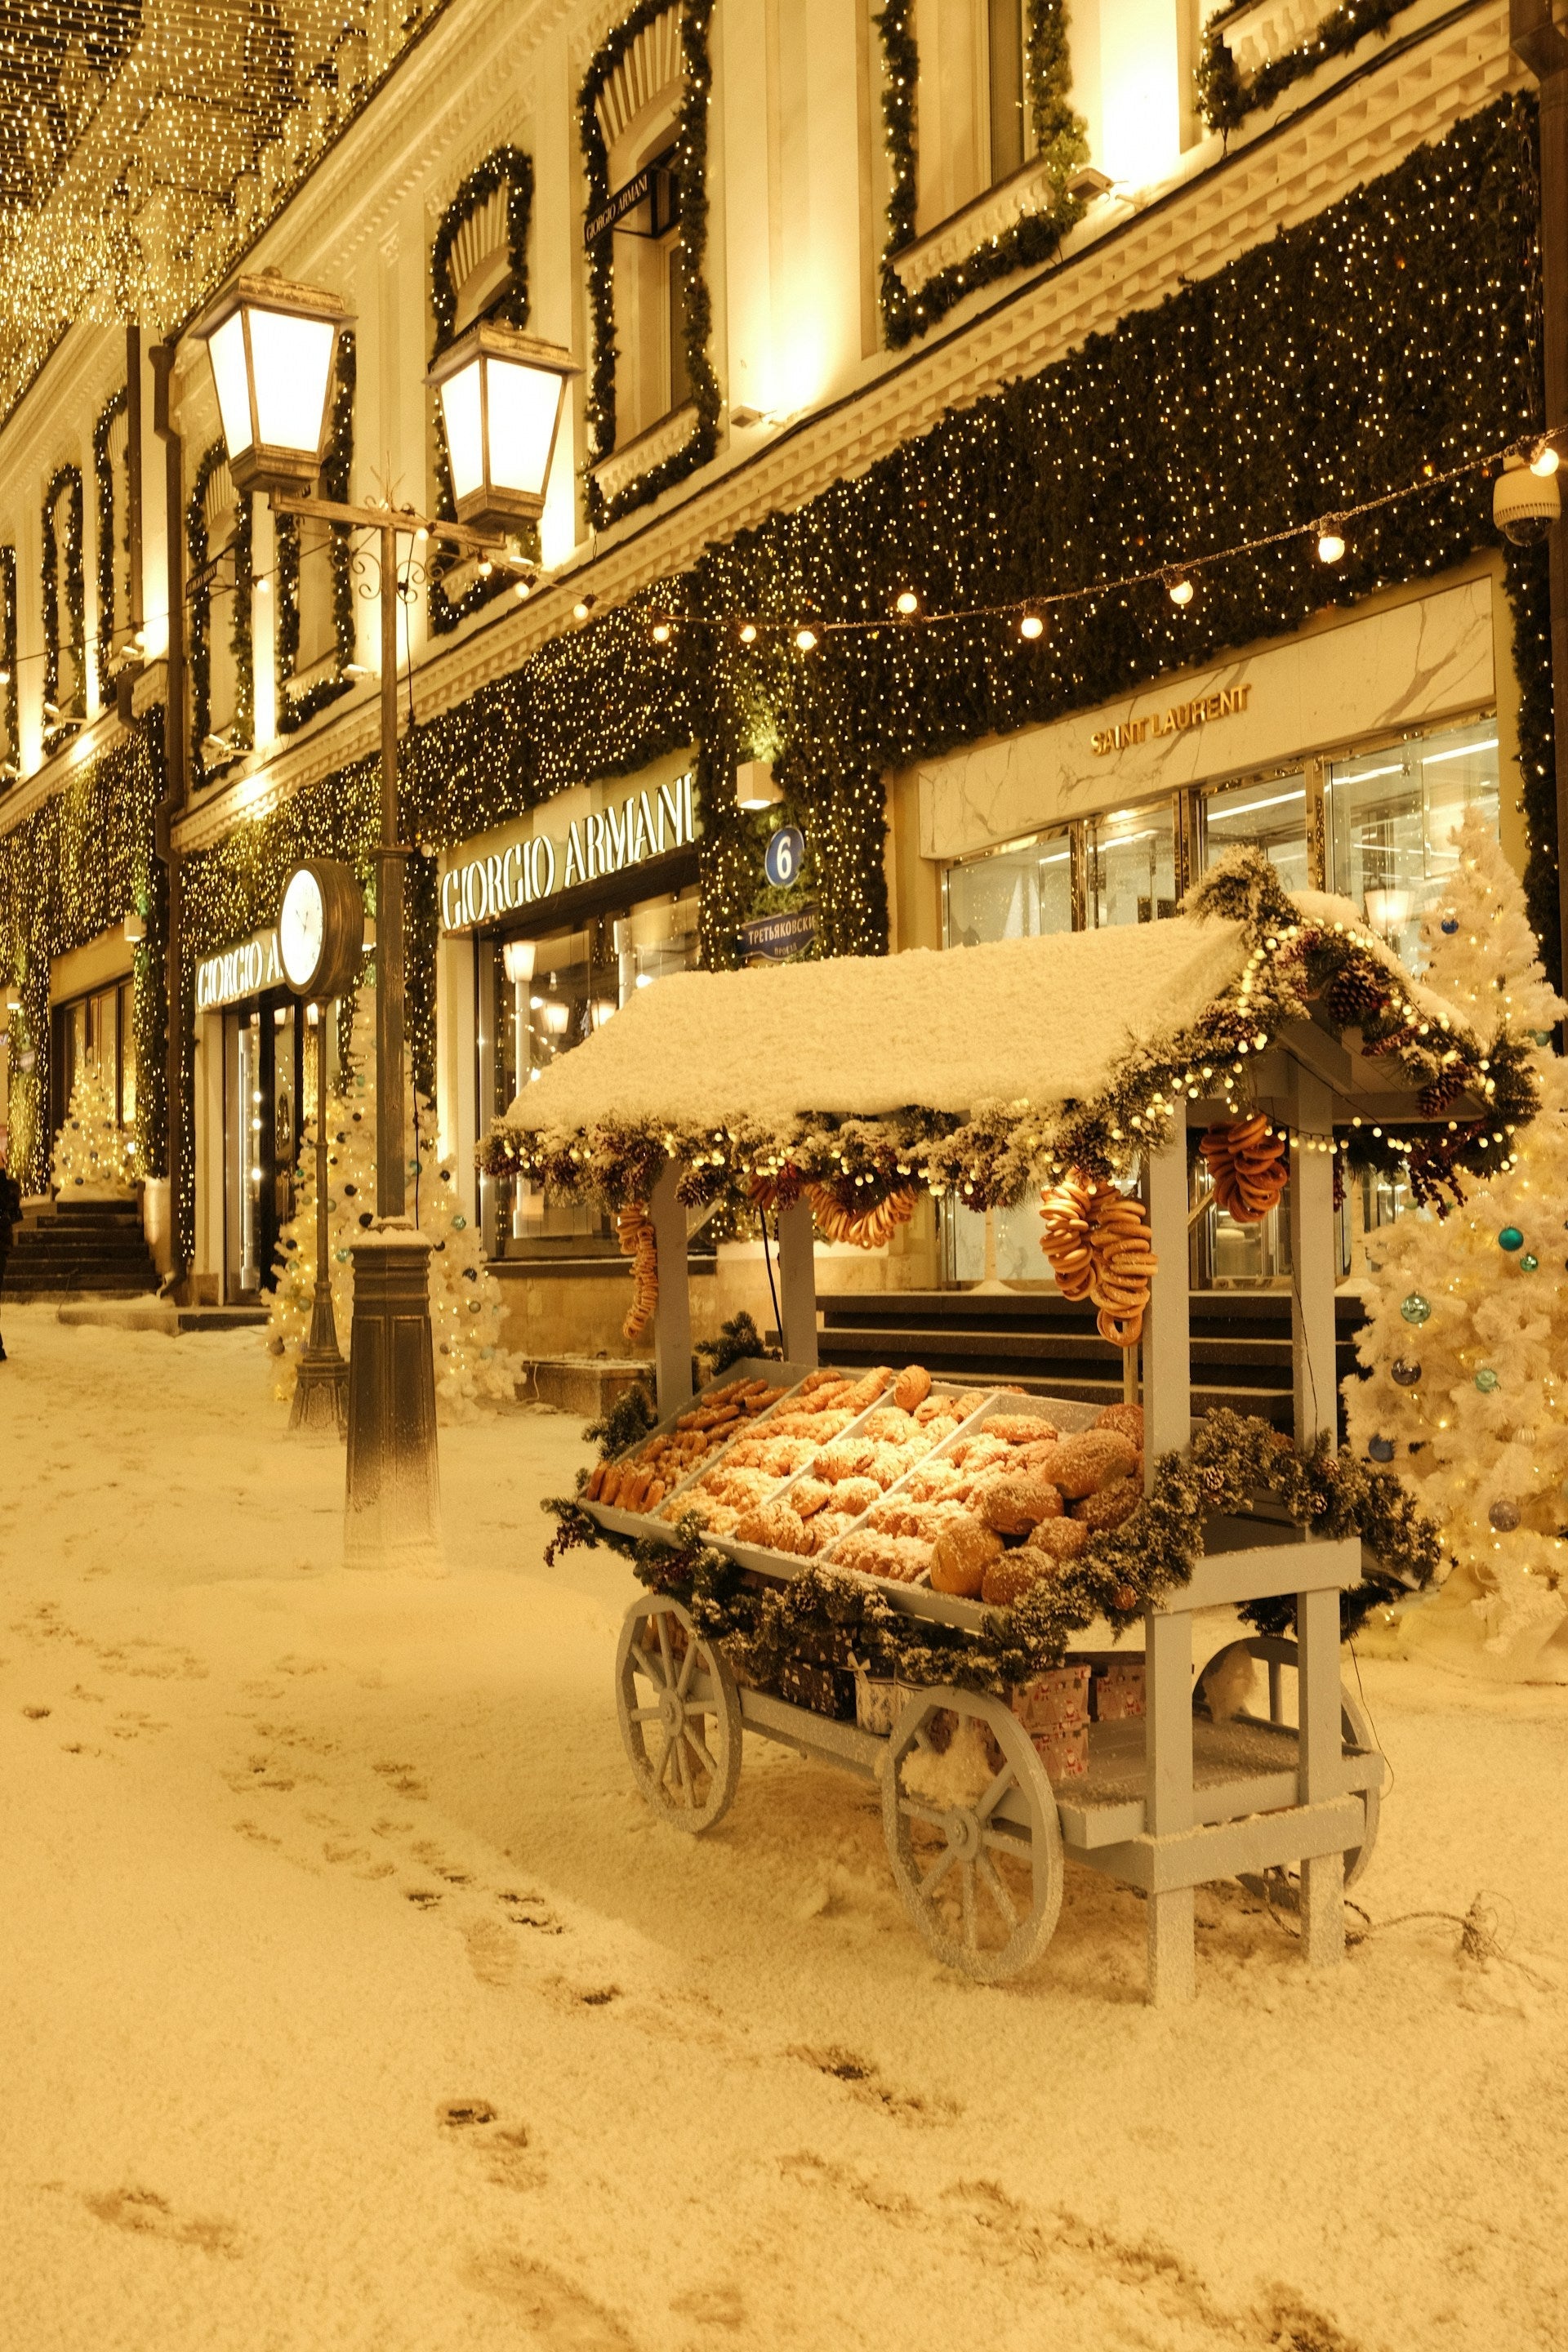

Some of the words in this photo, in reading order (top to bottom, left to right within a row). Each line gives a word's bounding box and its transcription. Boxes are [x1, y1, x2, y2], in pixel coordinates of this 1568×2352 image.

[586, 203, 617, 242] GIORGIO
[617, 174, 648, 215] ARMANI
[1091, 717, 1148, 756] SAINT
[1152, 684, 1251, 737] LAURENT
[442, 835, 555, 930] GIORGIO
[563, 773, 694, 889] ARMANI
[776, 835, 792, 880] 6
[748, 915, 815, 946] ТРЕТЬЯКОВСКИ
[197, 940, 263, 1008] GIORGIO
